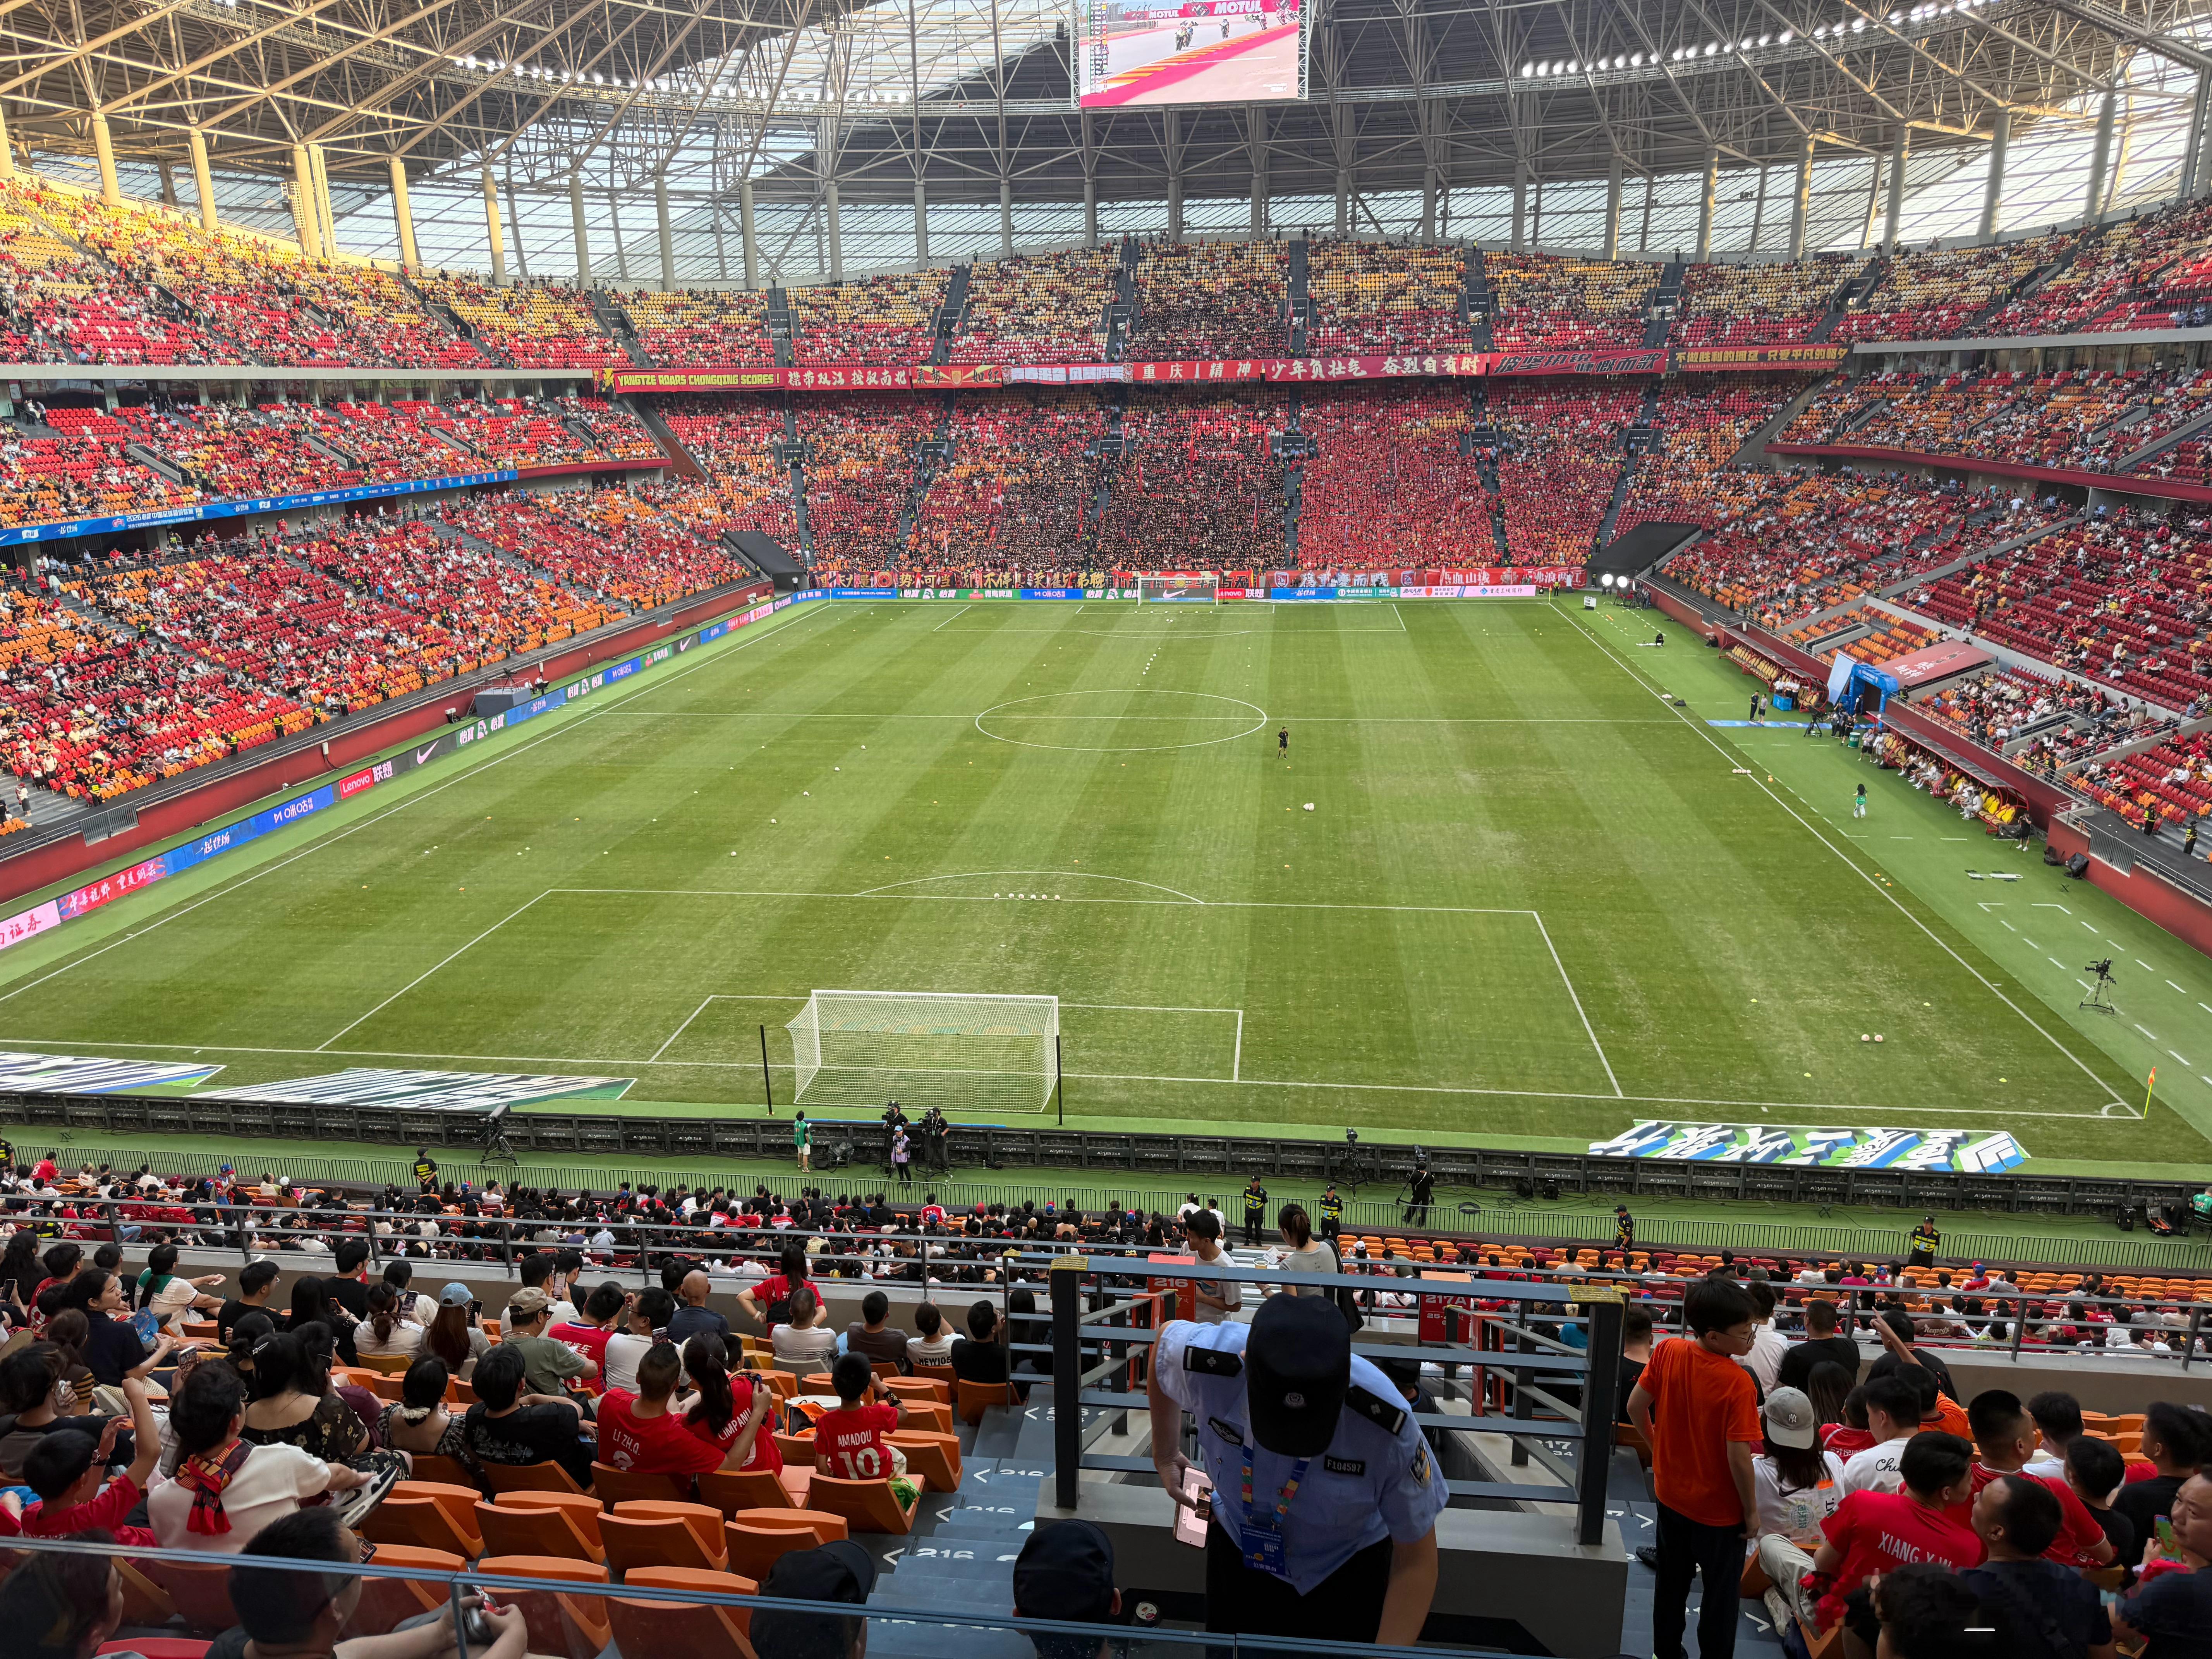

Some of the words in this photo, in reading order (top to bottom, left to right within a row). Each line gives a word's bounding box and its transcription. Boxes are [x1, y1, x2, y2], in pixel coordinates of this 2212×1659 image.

[1214, 0, 1262, 14] MOTUL
[1149, 10, 1179, 19] MOTUL
[1142, 363, 1183, 379] 重庆
[1209, 361, 1252, 378] 精神
[1271, 358, 1367, 380] 少年负壮气
[618, 374, 656, 387] YANGTZE
[658, 374, 687, 386] ROARS
[688, 374, 739, 386] CHONGQING
[740, 374, 774, 385] SCORES
[126, 514, 141, 522] 2026
[372, 761, 393, 783] 联想
[342, 775, 370, 793] Lenovo
[32, 1164, 41, 1175] 8
[1154, 1278, 1188, 1288] 216
[1425, 1294, 1467, 1305] 217A
[1923, 1324, 1950, 1336] Remedy
[613, 1429, 620, 1442] LI
[838, 1429, 872, 1447] AMADOU
[838, 1447, 881, 1480] 10
[1878, 1531, 1920, 1564] XIANG
